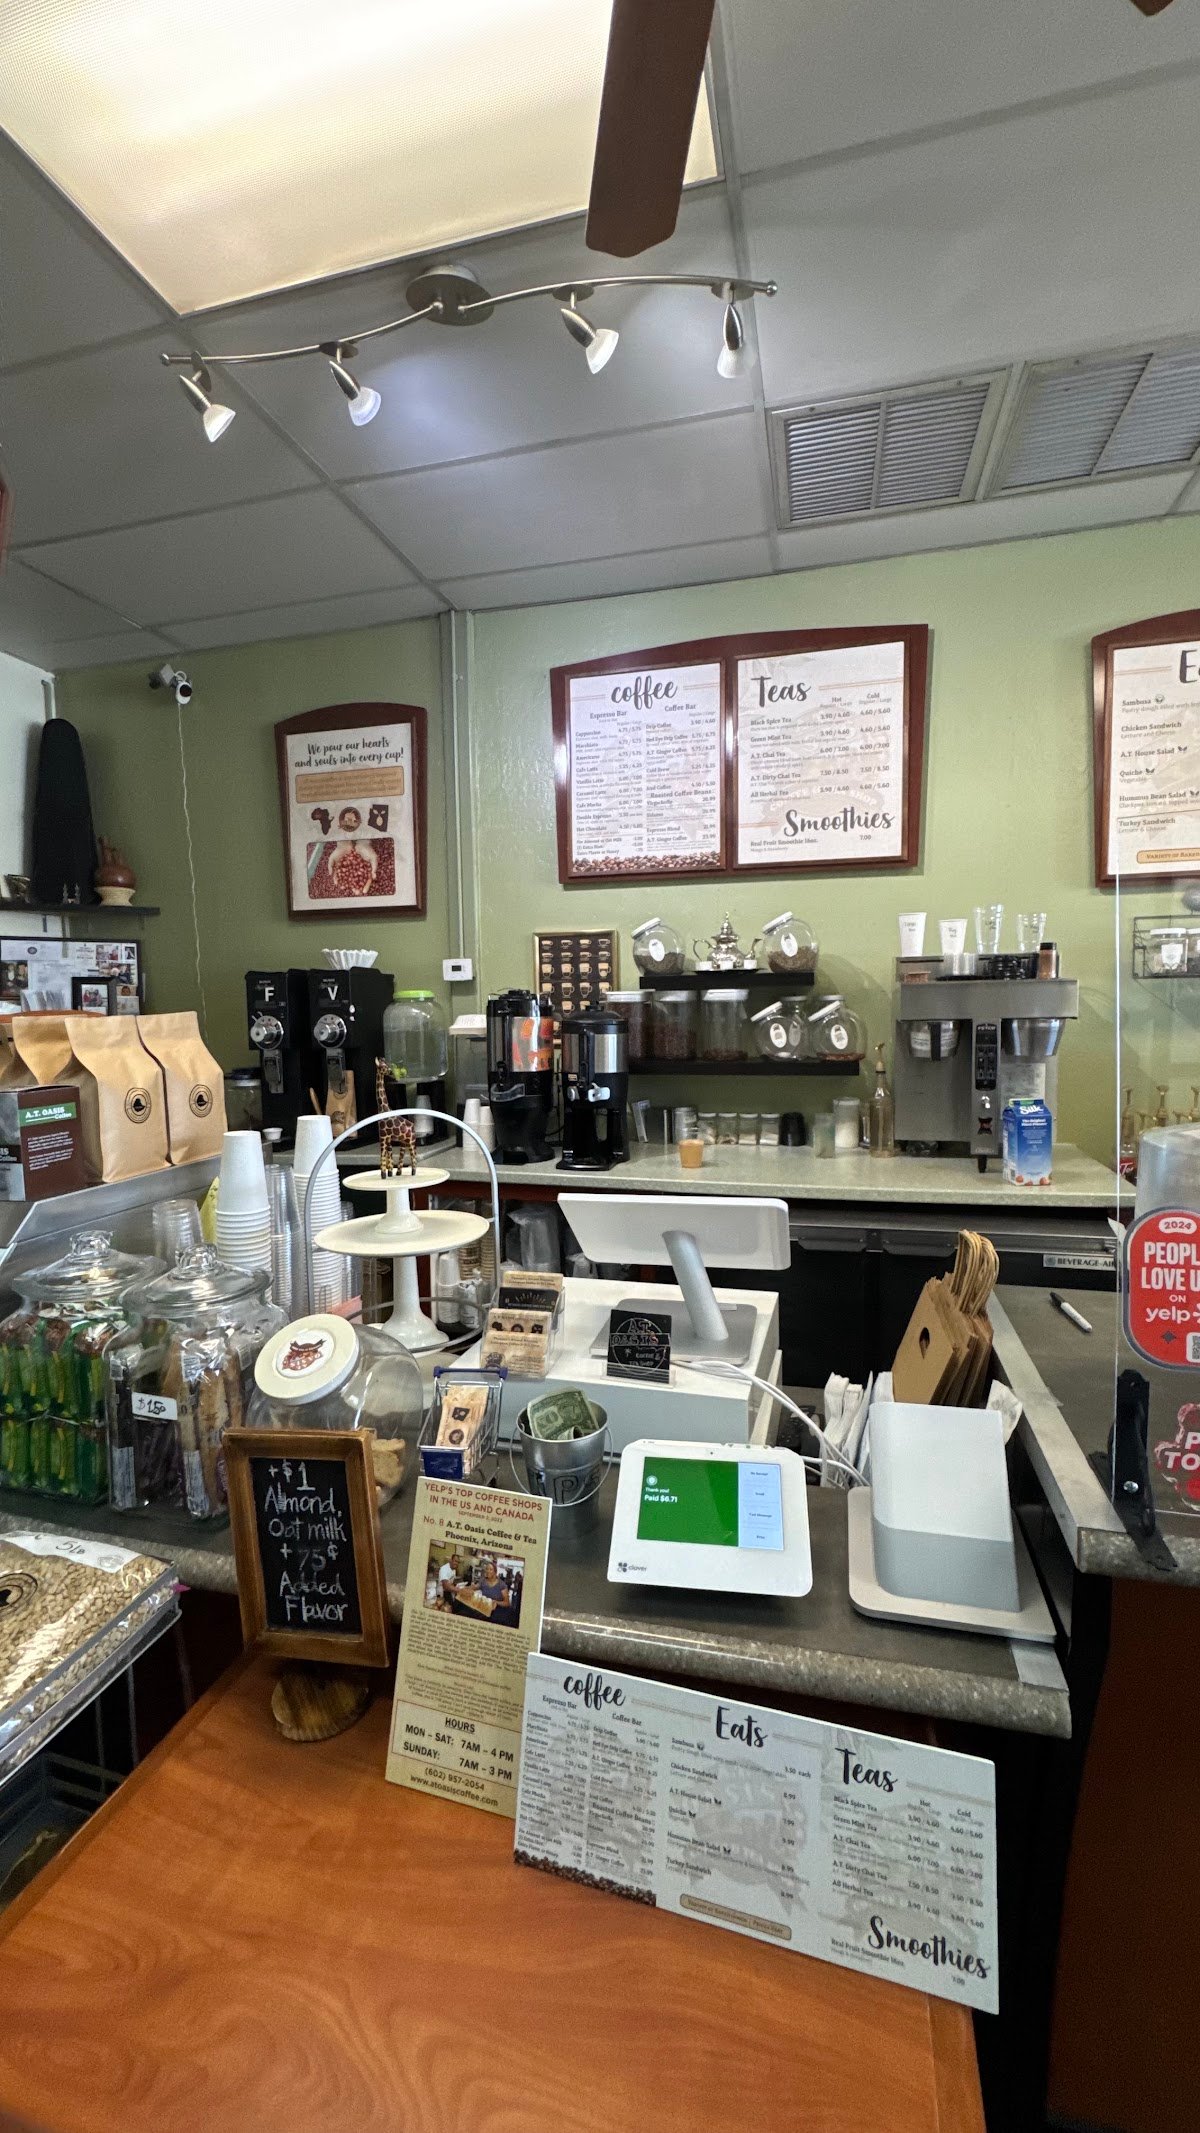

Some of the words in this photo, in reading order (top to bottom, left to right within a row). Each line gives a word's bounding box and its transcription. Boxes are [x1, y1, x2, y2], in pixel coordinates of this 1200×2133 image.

[611, 676, 678, 710] coffee
[751, 676, 811, 708] Teas
[590, 712, 615, 720] Espresso
[767, 718, 780, 726] Spice
[1122, 724, 1147, 732] Chicken
[308, 744, 320, 755] We
[324, 744, 342, 756] pour
[345, 742, 359, 750] our
[363, 736, 389, 748] hearts
[295, 756, 312, 768] and
[315, 754, 337, 767] souls
[341, 753, 356, 764] into
[359, 753, 382, 764] every
[385, 747, 404, 762] cup!
[784, 806, 894, 837] Smoothies
[265, 987, 274, 1001] F
[328, 986, 338, 1000] V
[42, 1107, 65, 1115] OASIS
[1020, 1105, 1040, 1114] Silk
[1164, 1221, 1192, 1230] 2024
[1144, 1242, 1200, 1266] PEOPL
[1142, 1267, 1186, 1290] LOVE
[1190, 1269, 1200, 1291] U
[1169, 1295, 1186, 1303] ON
[1145, 1306, 1190, 1324] yelp
[425, 1482, 452, 1494] YELP'S
[456, 1488, 473, 1498] TOP
[476, 1492, 509, 1505] COFFEE
[512, 1498, 542, 1511] SHOPS
[660, 1495, 677, 1503] $6.71
[430, 1495, 438, 1503] IN
[442, 1497, 457, 1507] THE
[460, 1501, 471, 1509] US
[474, 1504, 492, 1514] AND
[496, 1508, 534, 1522] CANADA
[269, 1517, 304, 1540] Oat
[308, 1517, 347, 1542] milk
[424, 1516, 436, 1525] No.
[446, 1521, 462, 1530] A.T.
[464, 1525, 484, 1534] Oasis
[487, 1529, 512, 1540] Coffee
[523, 1535, 536, 1544] Tea
[445, 1531, 479, 1544] Phoenix,
[481, 1539, 513, 1551] Arizona
[280, 1571, 346, 1596] Added
[285, 1595, 348, 1622] Flavor
[542, 1696, 566, 1706] Espresso
[564, 1672, 626, 1710] coffee
[445, 1717, 475, 1733] HOURS
[612, 1714, 630, 1723] Coffee
[632, 1718, 642, 1726] Bar
[715, 1705, 768, 1748] Eats
[405, 1724, 425, 1737] MON
[435, 1733, 454, 1745] SAT:
[461, 1740, 480, 1753] 7AM
[491, 1748, 497, 1757] 4
[499, 1751, 514, 1762] PM
[403, 1742, 441, 1760] SUNDAY:
[459, 1758, 479, 1771] 7AM
[489, 1766, 495, 1775] 3
[498, 1769, 512, 1780] PM
[671, 1763, 691, 1773] Chicken
[692, 1768, 717, 1779] Sandwich
[835, 1748, 898, 1792] Teas
[425, 1767, 446, 1781] (602)
[448, 1774, 484, 1791] 957-2054
[411, 1775, 498, 1806] www.atoasiscoffee.com
[868, 1804, 877, 1812] Tea
[957, 1809, 971, 1817] Cold
[667, 1856, 684, 1868] Turkey
[686, 1862, 711, 1875] Sandwich
[868, 1915, 990, 1979] Smoothies
